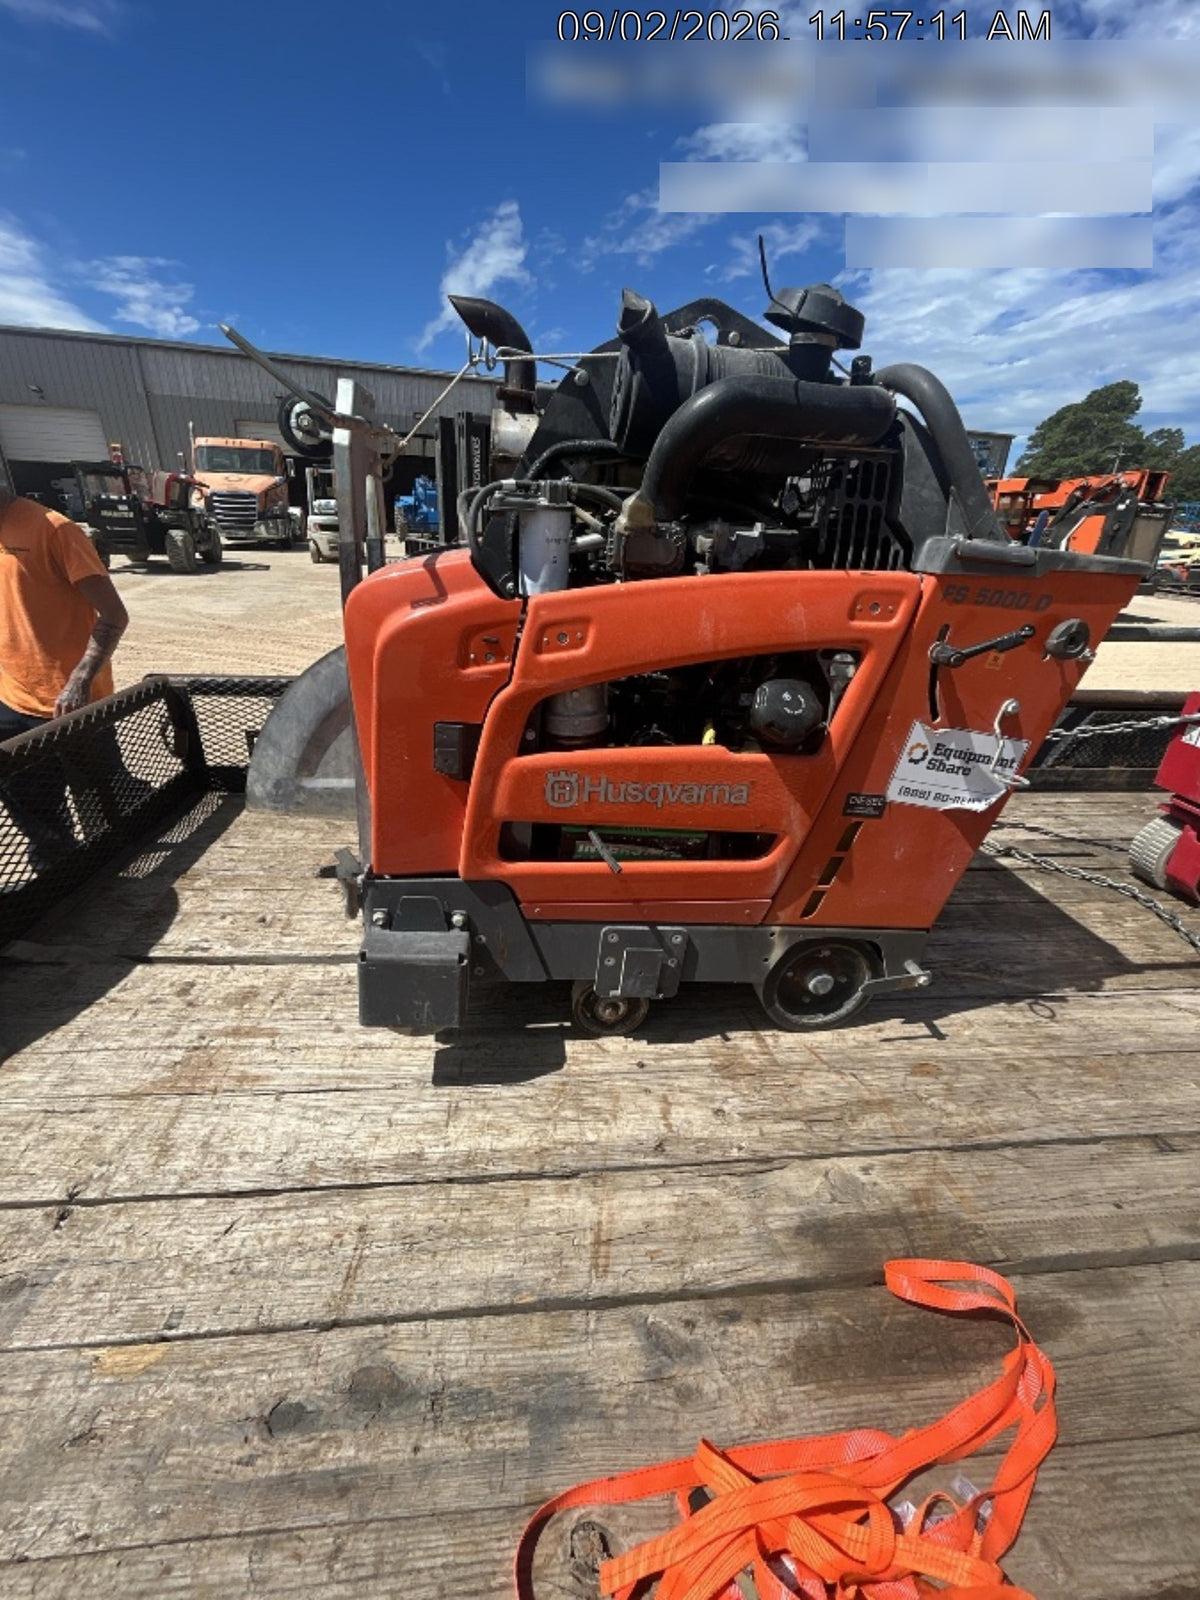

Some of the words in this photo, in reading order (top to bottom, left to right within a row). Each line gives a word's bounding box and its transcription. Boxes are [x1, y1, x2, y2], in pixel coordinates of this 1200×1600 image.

[943, 584, 969, 604] FS
[974, 588, 1031, 610] 5000
[1034, 594, 1053, 612] D
[926, 758, 972, 776] Share
[932, 743, 1016, 769] Equipmnt
[583, 774, 749, 808] Husqvarna
